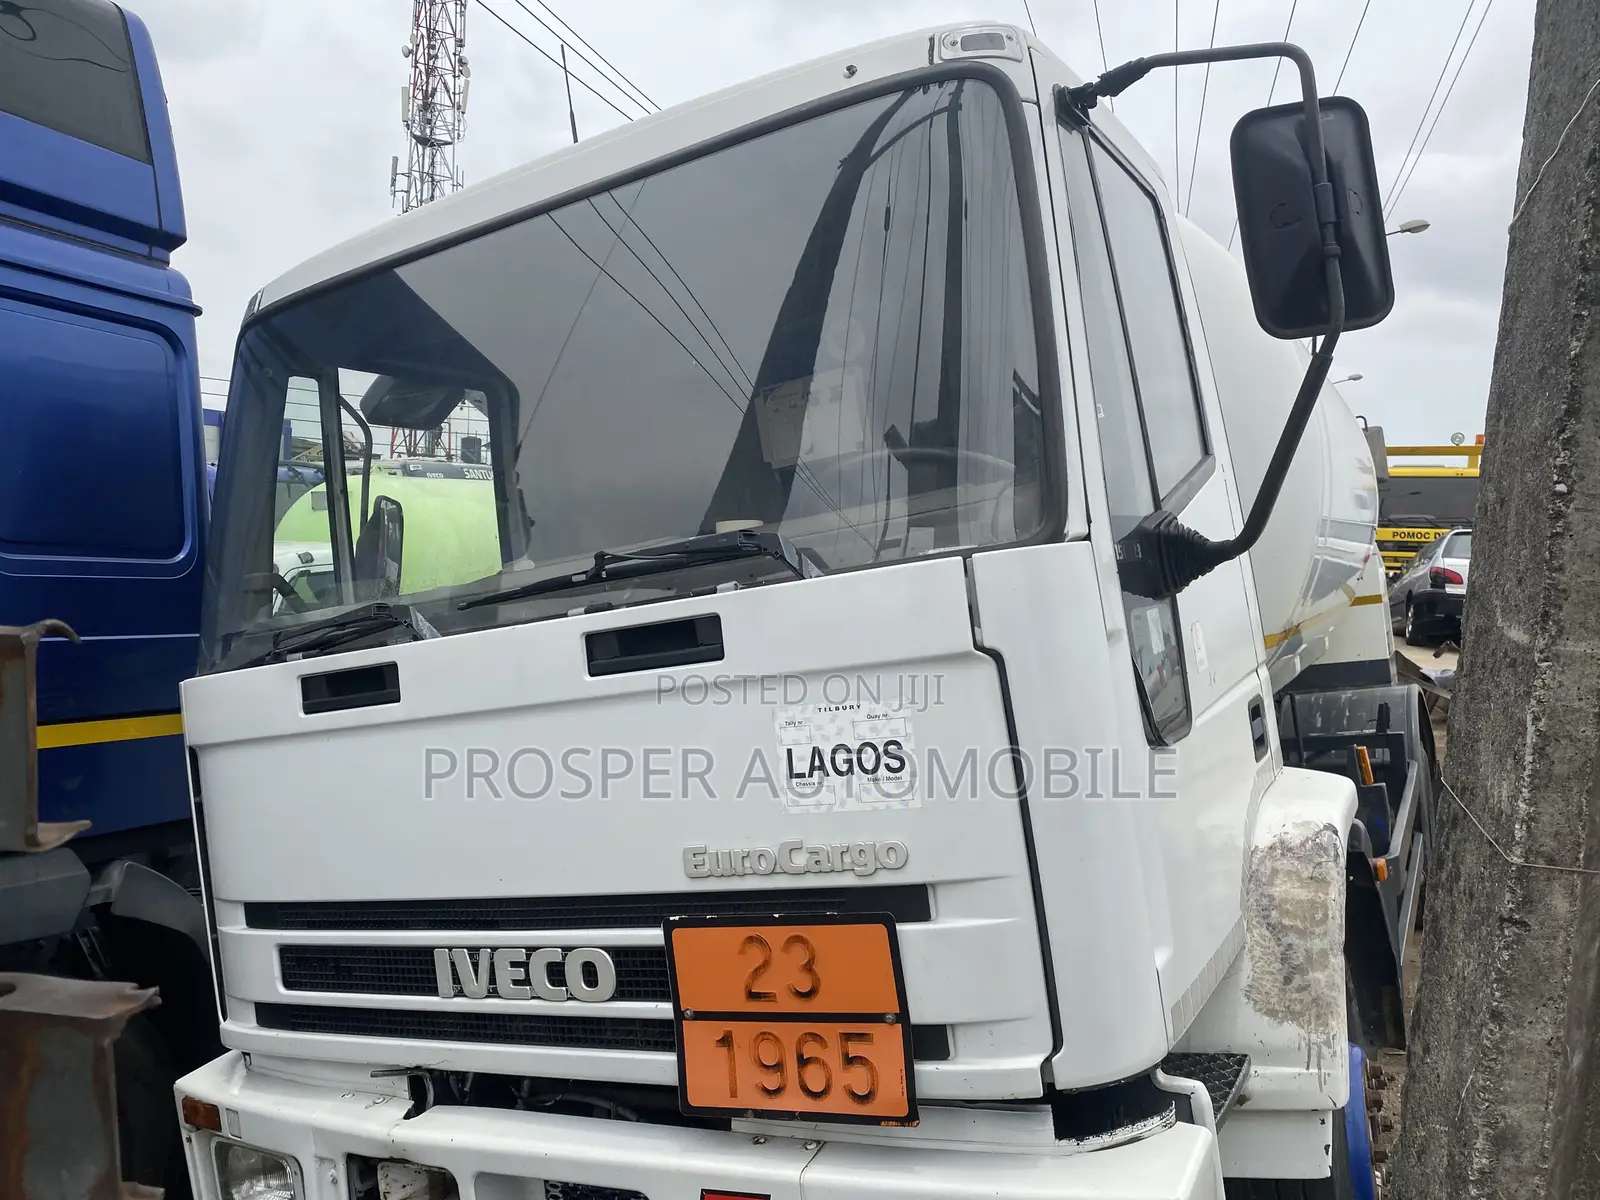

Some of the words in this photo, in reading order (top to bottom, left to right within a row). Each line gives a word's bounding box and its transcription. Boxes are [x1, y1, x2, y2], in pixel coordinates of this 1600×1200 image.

[1392, 531, 1431, 540] POMOC
[817, 704, 861, 712] TILBURY
[786, 739, 906, 779] LAGOS
[683, 838, 908, 878] EuroCargo
[433, 947, 616, 1003] IVECO
[738, 932, 821, 1003] 23
[715, 1029, 879, 1106] 1965
